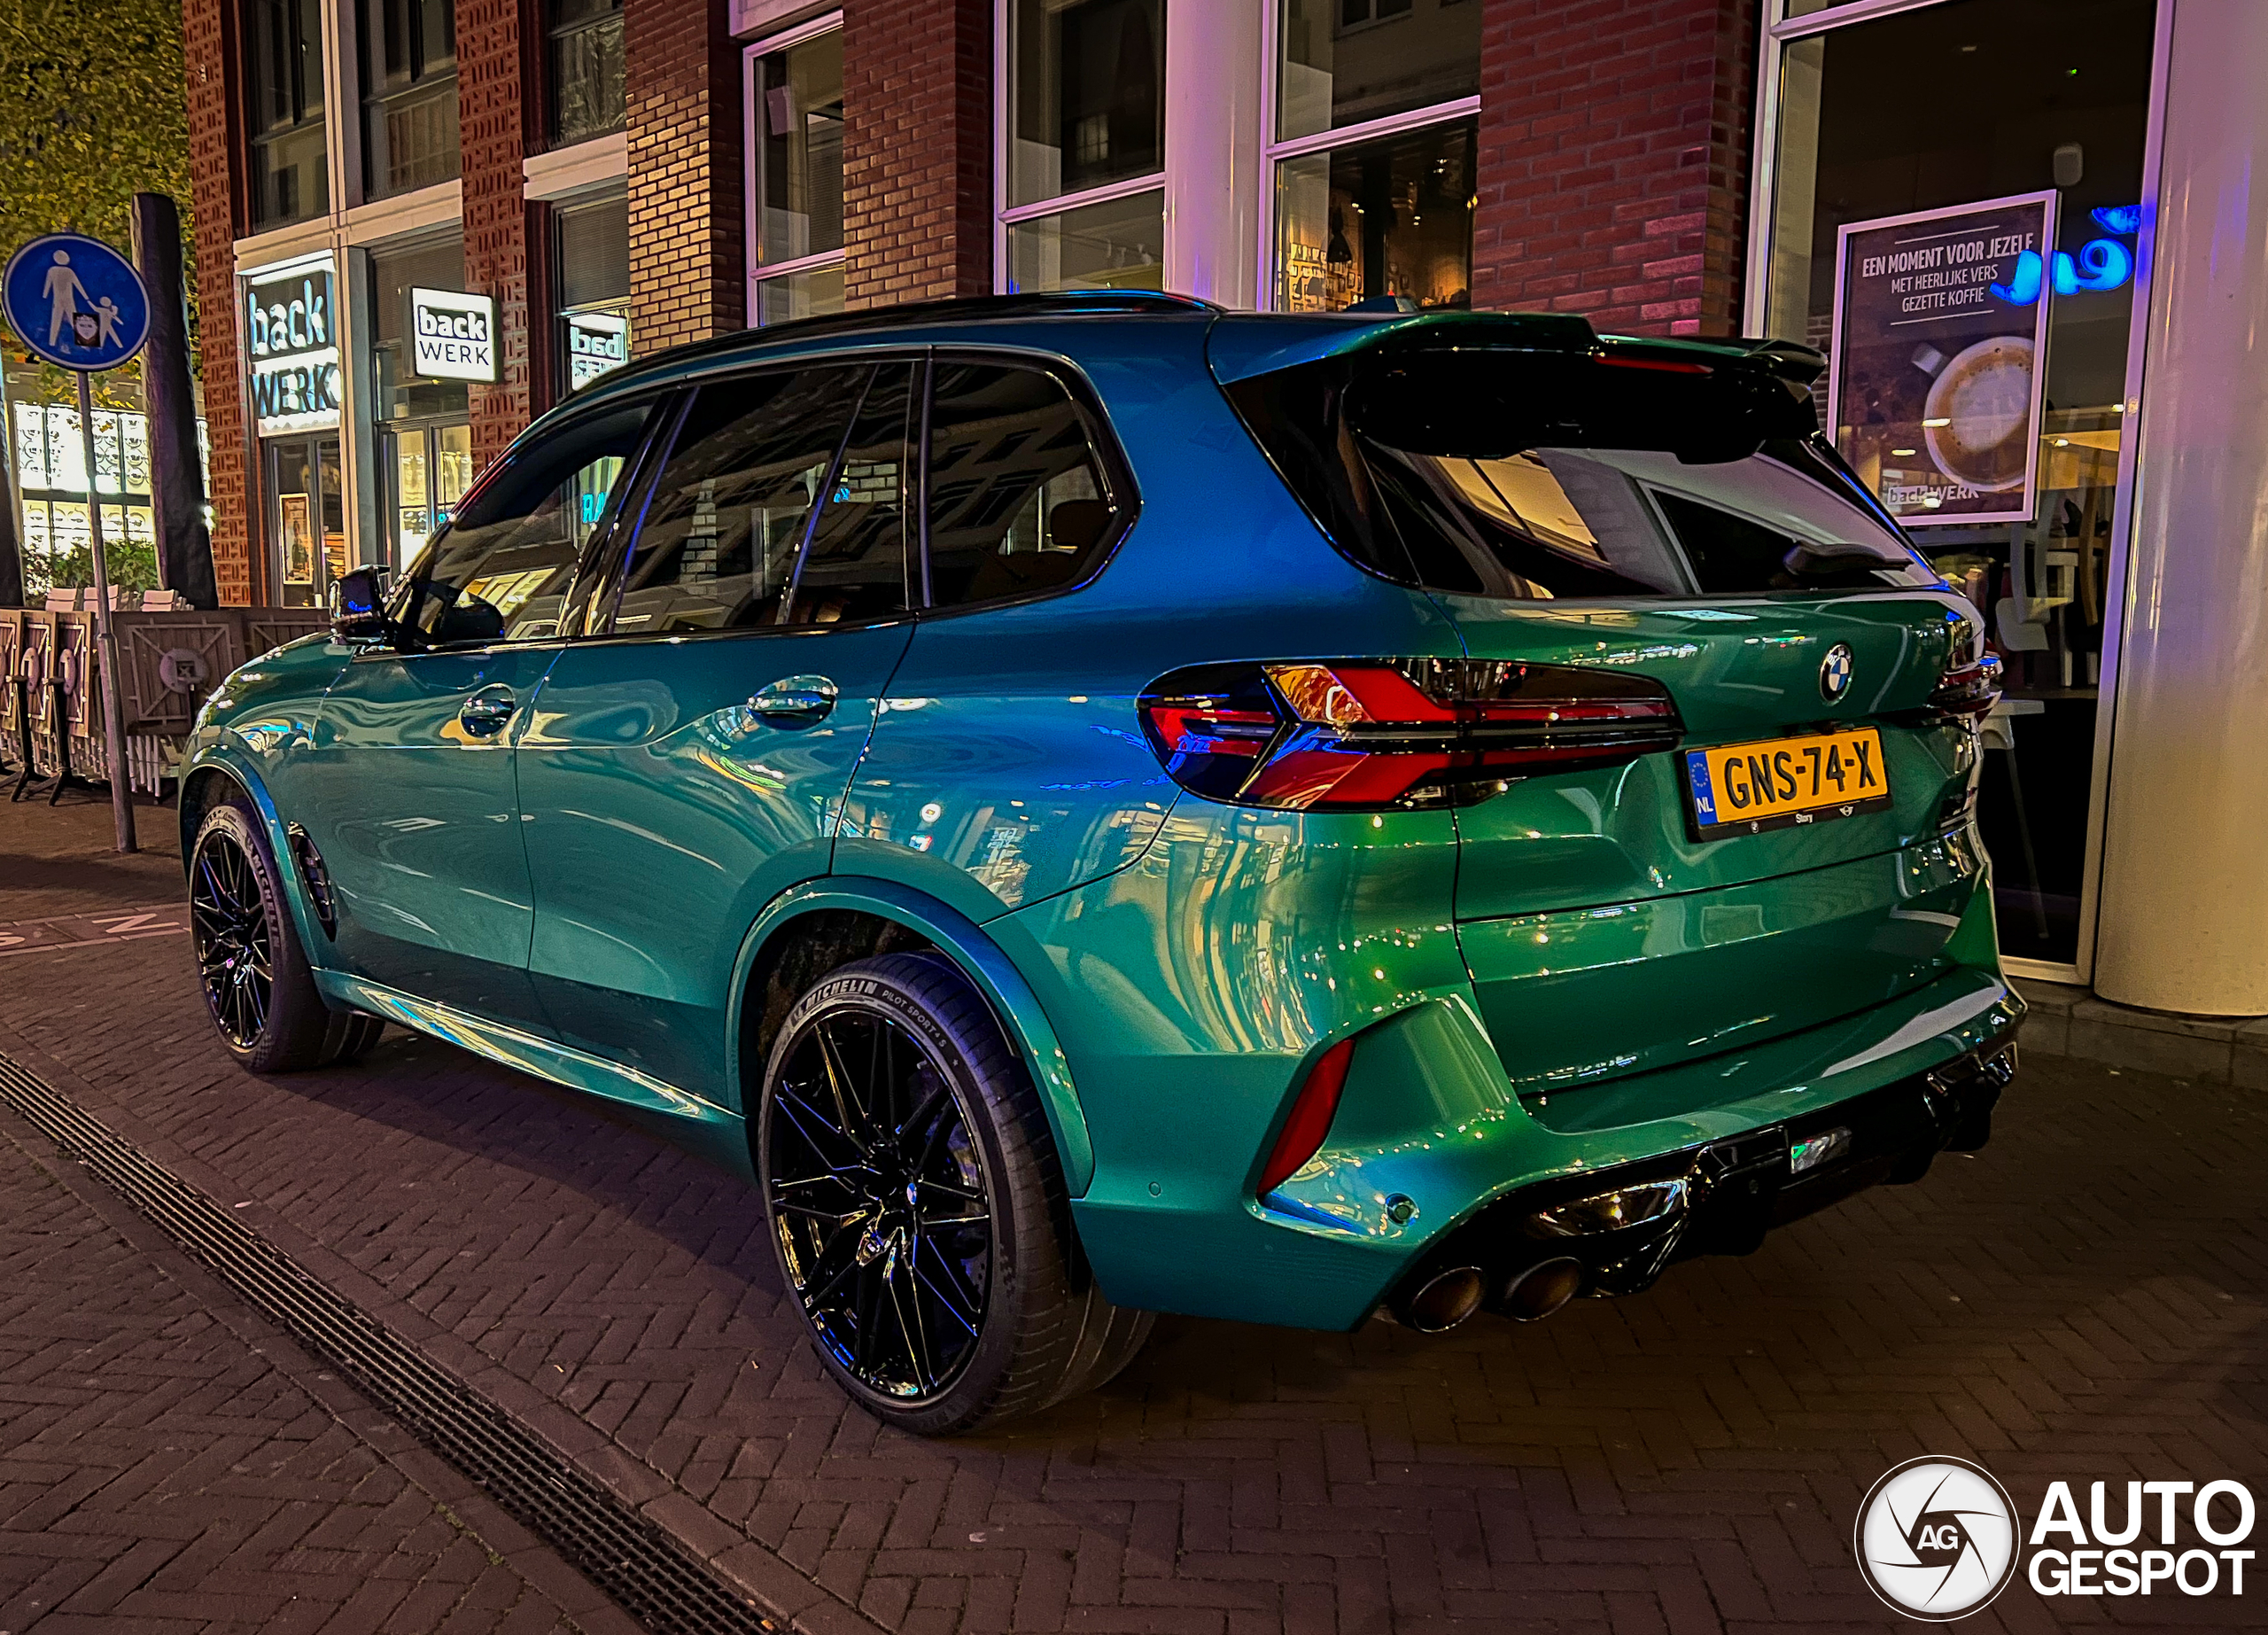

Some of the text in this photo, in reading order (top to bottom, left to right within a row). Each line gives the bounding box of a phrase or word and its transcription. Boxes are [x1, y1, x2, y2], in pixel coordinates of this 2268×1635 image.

[1862, 256, 1886, 277] EEN
[1888, 247, 1944, 275] MOMENT
[1946, 240, 1984, 265] VOOR
[1891, 264, 1999, 294] MET HEERLIJKE VERS
[249, 279, 325, 355] back
[1902, 287, 1984, 312] GEZETTE KOFFIE
[419, 306, 486, 341] back
[419, 340, 489, 366] WERK
[252, 362, 339, 418] WERK
[1724, 741, 1877, 810] GNS-74-X
[1696, 797, 1714, 814] NL
[805, 979, 878, 1010] MICHELIN
[882, 989, 908, 1008] PILOT
[907, 1005, 936, 1033] SPORT
[938, 1039, 948, 1048] S
